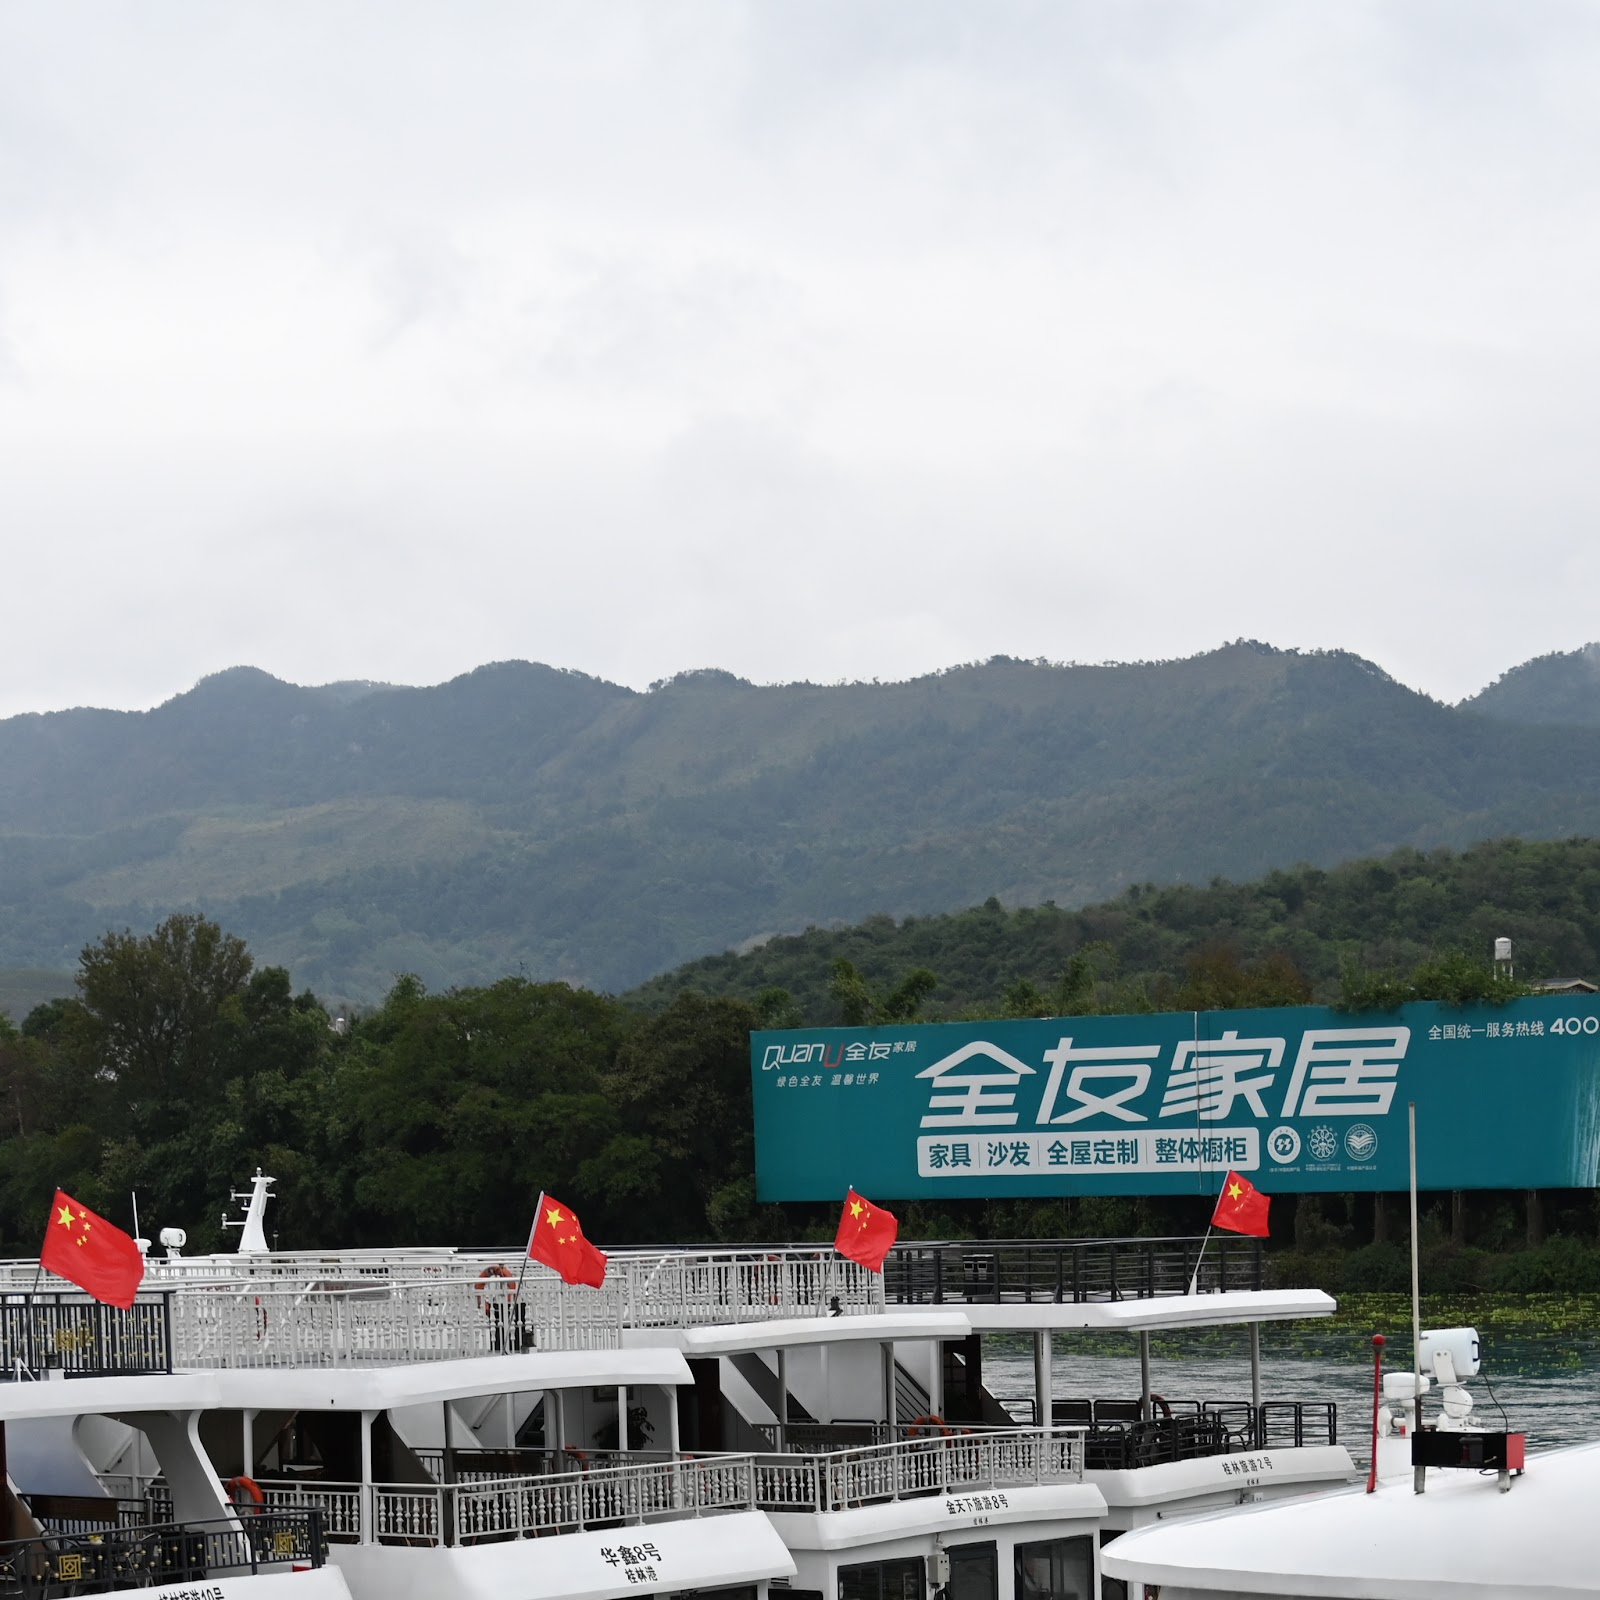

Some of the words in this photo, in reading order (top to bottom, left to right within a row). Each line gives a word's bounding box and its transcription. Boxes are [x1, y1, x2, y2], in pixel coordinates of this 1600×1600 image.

[1428, 1021, 1545, 1041] 全国统一服务热线
[776, 1075, 823, 1088] 绿色全友
[830, 1072, 880, 1086] 温馨世界
[914, 1026, 1409, 1129] 全友家居
[928, 1143, 972, 1169] 家具
[987, 1141, 1031, 1167] 沙发
[1047, 1138, 1139, 1166] 全屋定制
[1155, 1136, 1248, 1165] 整体橱柜
[1221, 1456, 1273, 1475] 桂林旅游2号
[945, 1493, 1009, 1515] 金天下旅游8号
[600, 1543, 662, 1567] 华鑫8号
[624, 1566, 658, 1584] 桂林港
